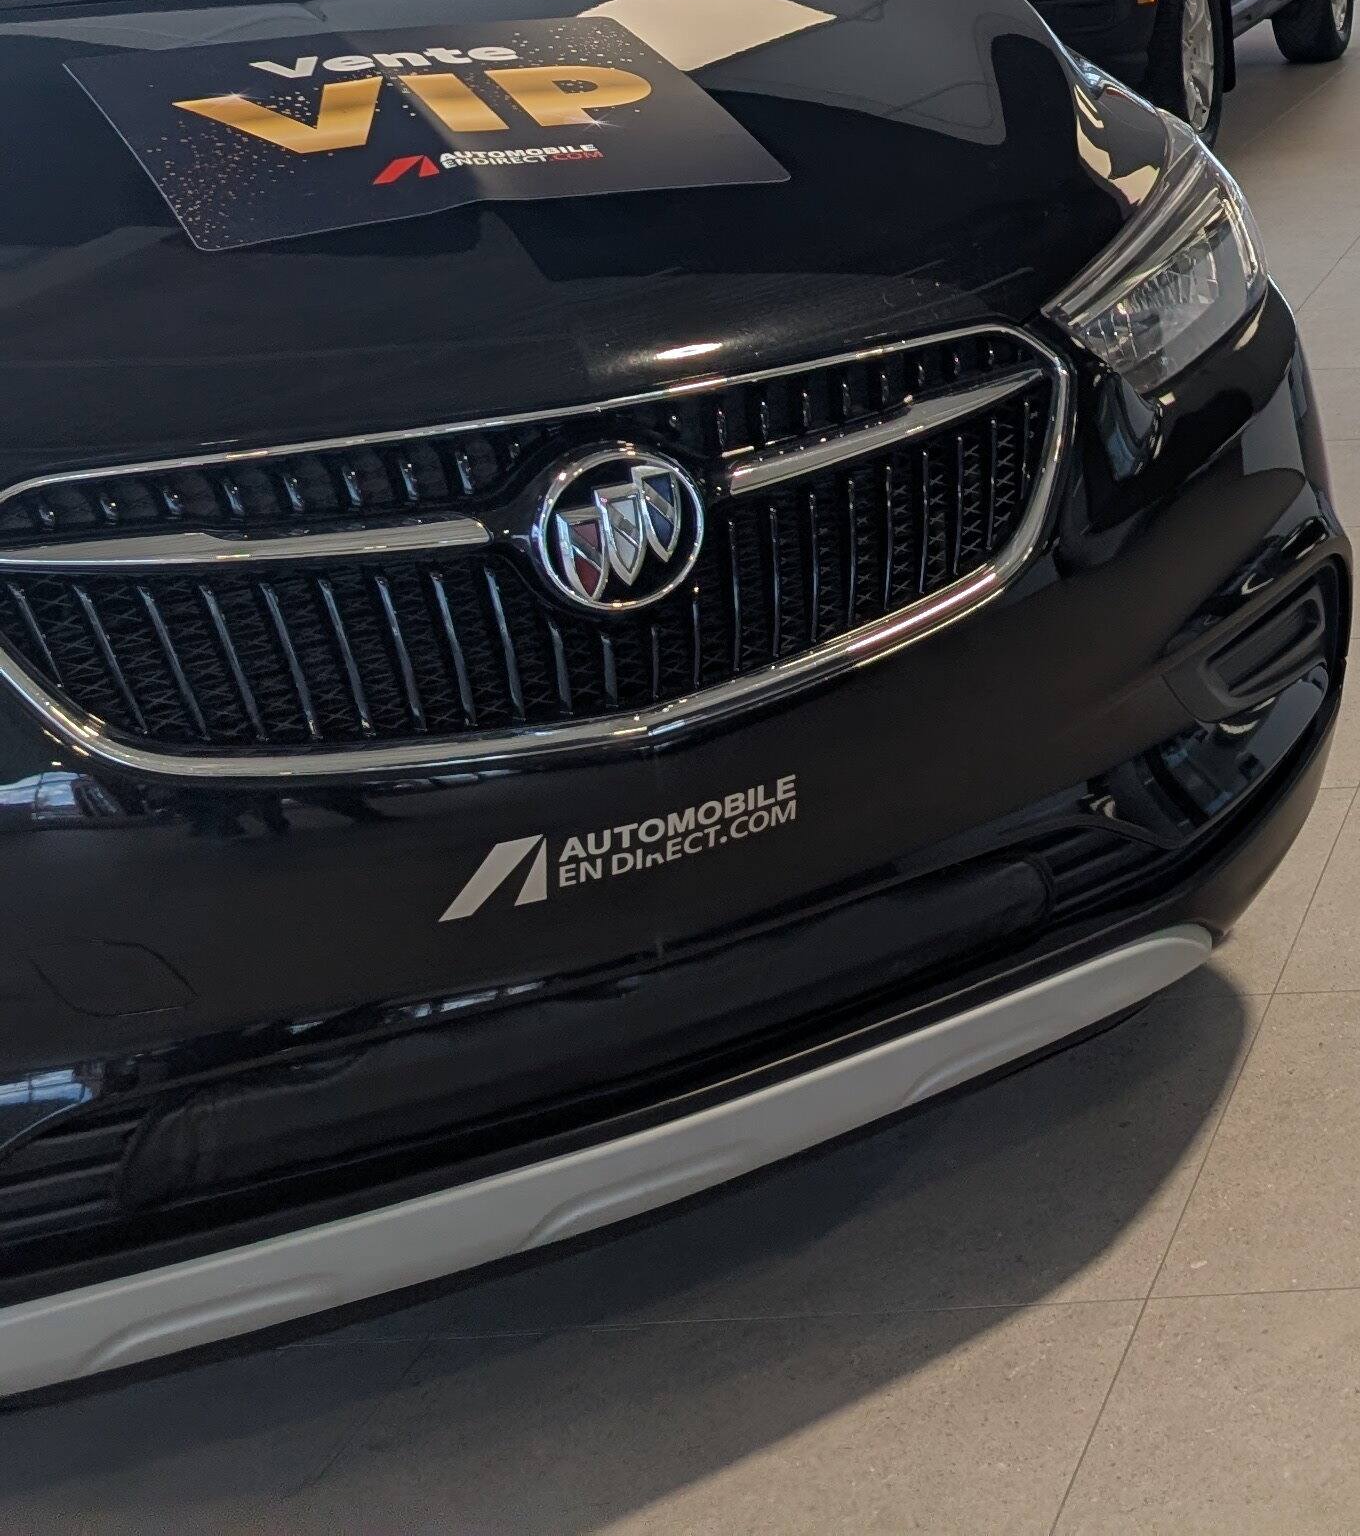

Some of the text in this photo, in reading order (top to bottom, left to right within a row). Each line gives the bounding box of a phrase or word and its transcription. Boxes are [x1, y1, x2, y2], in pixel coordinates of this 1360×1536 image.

[249, 44, 520, 79] Vente
[171, 64, 653, 154] VIP
[439, 143, 600, 163] AUTOMOBILE
[558, 773, 797, 863] AUTOMOBILE
[558, 859, 602, 888] EN
